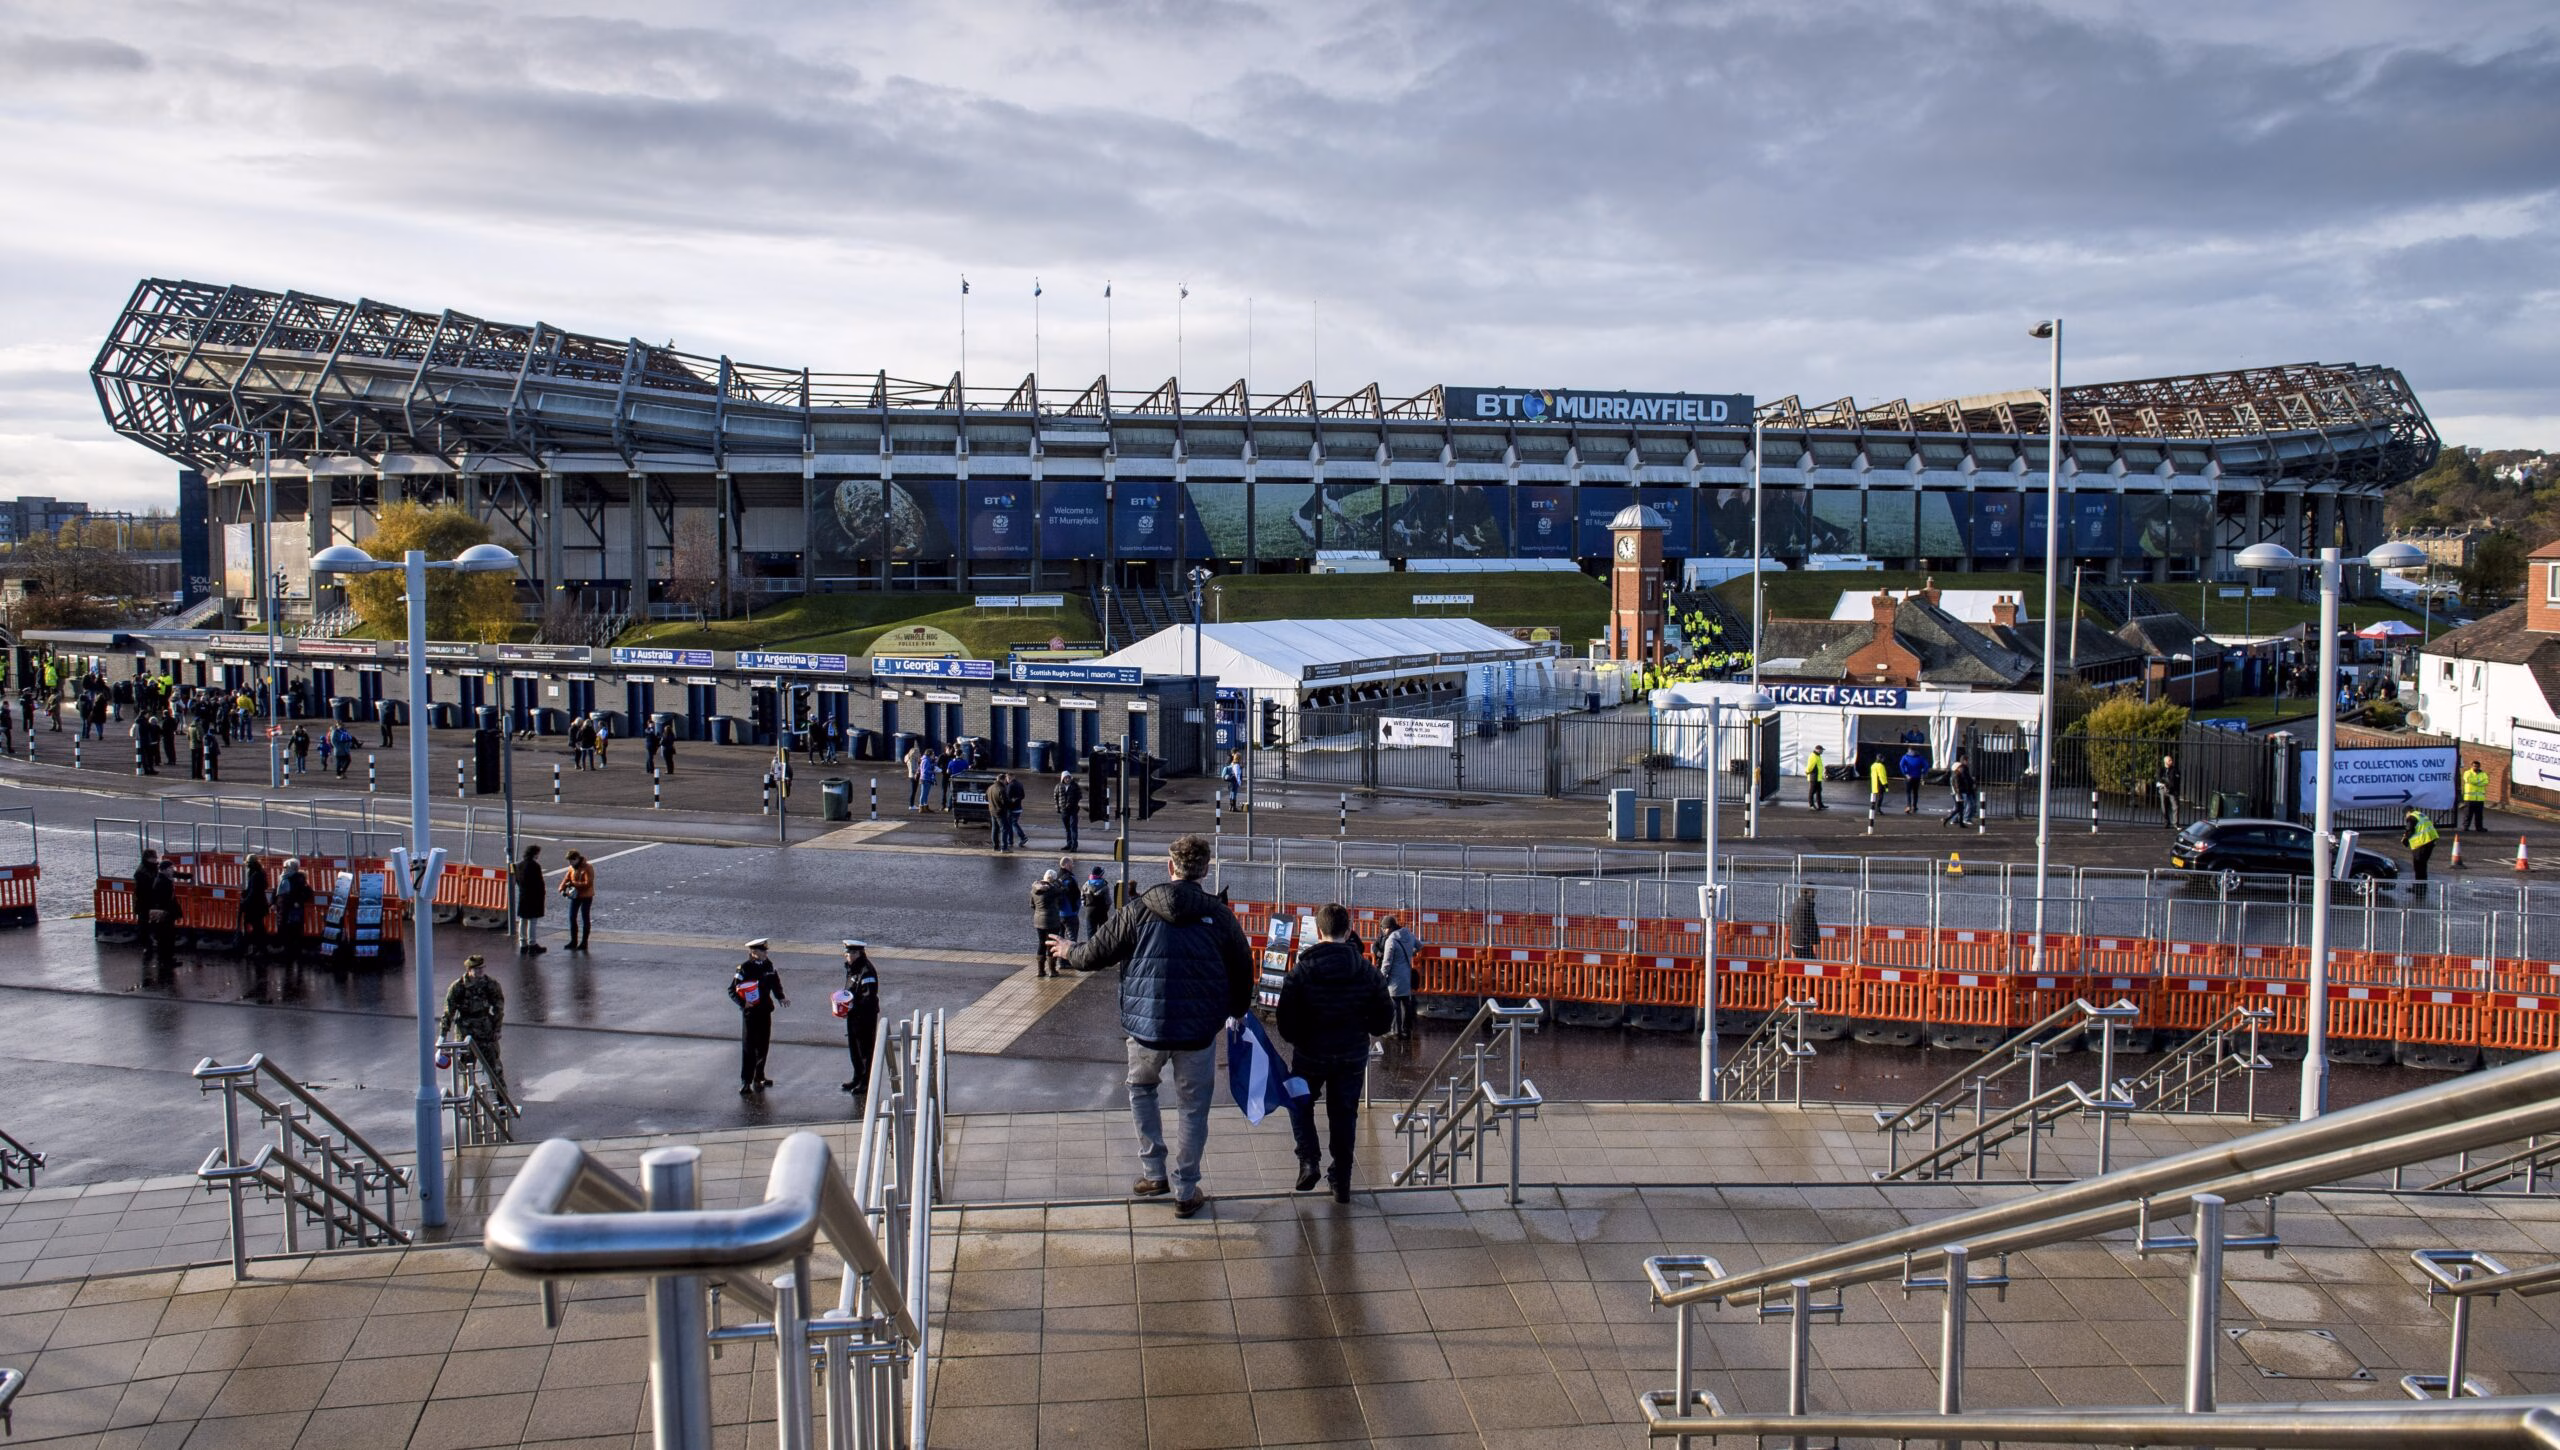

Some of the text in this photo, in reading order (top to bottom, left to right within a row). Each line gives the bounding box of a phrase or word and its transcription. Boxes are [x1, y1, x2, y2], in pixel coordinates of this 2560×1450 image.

[1476, 394, 1728, 422] BT MURRAYFIELD
[984, 497, 1000, 505] BT
[1131, 498, 1146, 506] BT
[1054, 506, 1084, 514] Welcome
[1049, 516, 1099, 526] BT Murrayfield
[630, 649, 673, 660] v Australia
[757, 654, 807, 665] v Argentina
[894, 660, 939, 673] v Georgia
[1030, 669, 1052, 677] Scottish
[1052, 670, 1070, 678] Rugby
[1090, 671, 1116, 679] macron
[1769, 685, 1897, 706] TICKET SALES
[2517, 737, 2537, 748] TICKET
[2353, 759, 2418, 770] COLLECTIONS
[2422, 758, 2446, 768] ONLY
[2337, 772, 2452, 784] ACCREDITATION CENTRE
